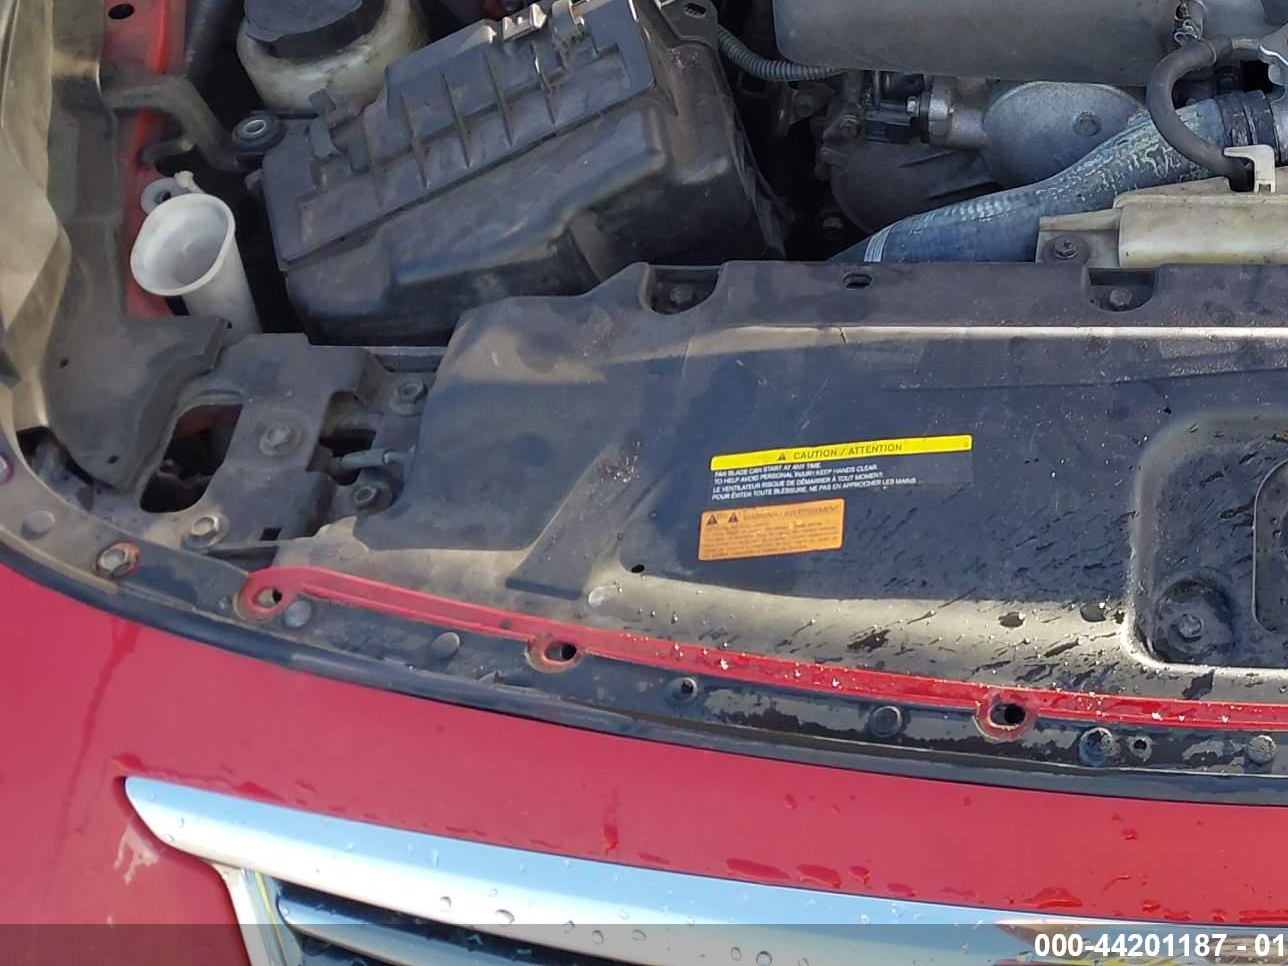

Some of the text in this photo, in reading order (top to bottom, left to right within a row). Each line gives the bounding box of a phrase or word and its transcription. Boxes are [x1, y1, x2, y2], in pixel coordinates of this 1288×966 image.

[794, 449, 836, 460] CAUTION
[848, 443, 902, 454] ATTENTION
[763, 465, 781, 473] START
[740, 475, 758, 483] AVOID
